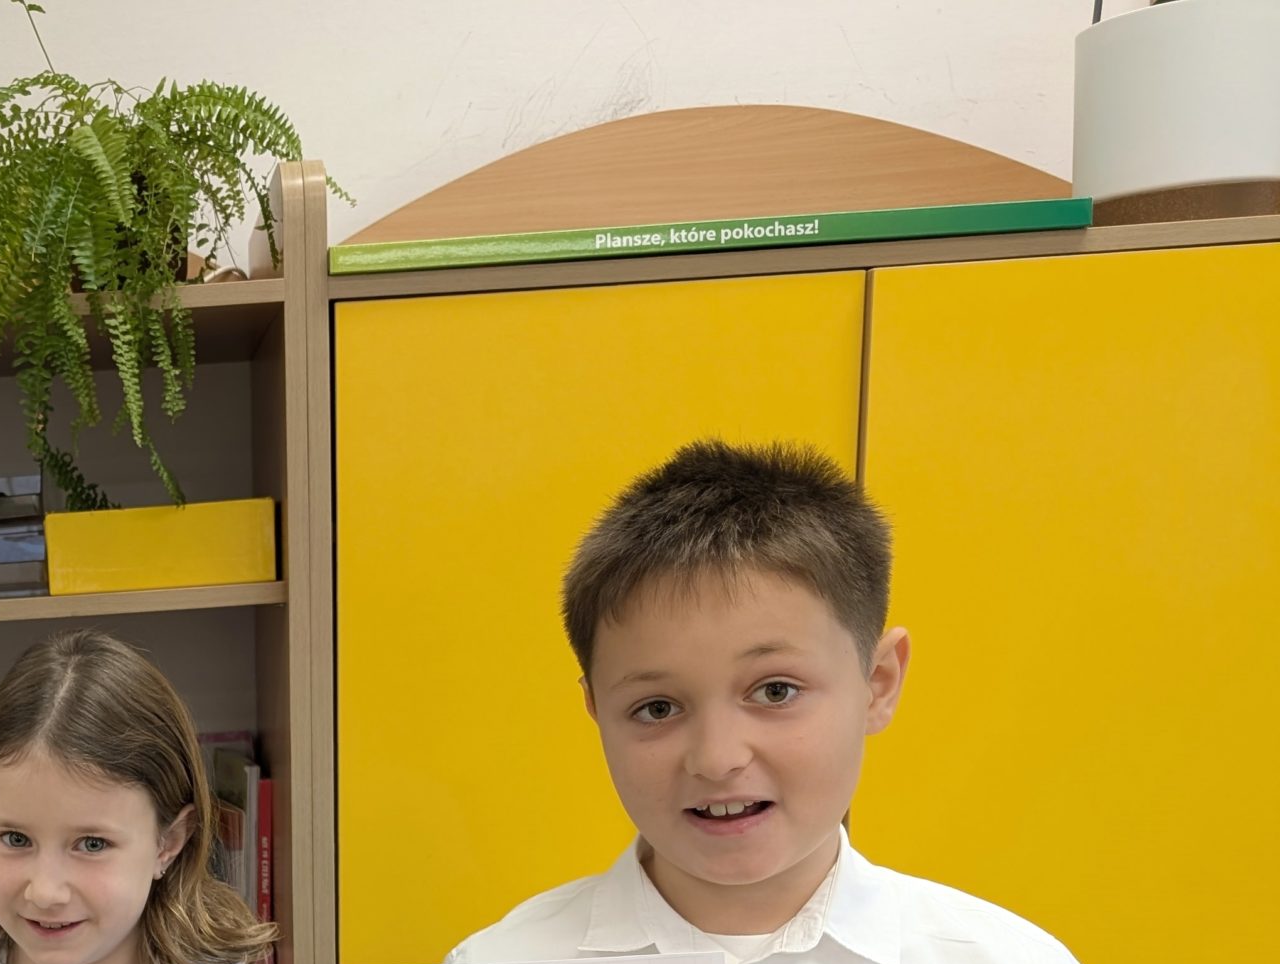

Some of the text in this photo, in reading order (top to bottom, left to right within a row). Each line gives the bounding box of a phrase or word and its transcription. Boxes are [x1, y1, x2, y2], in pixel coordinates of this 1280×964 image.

[594, 219, 820, 249] Plansze, które pokochasz!
